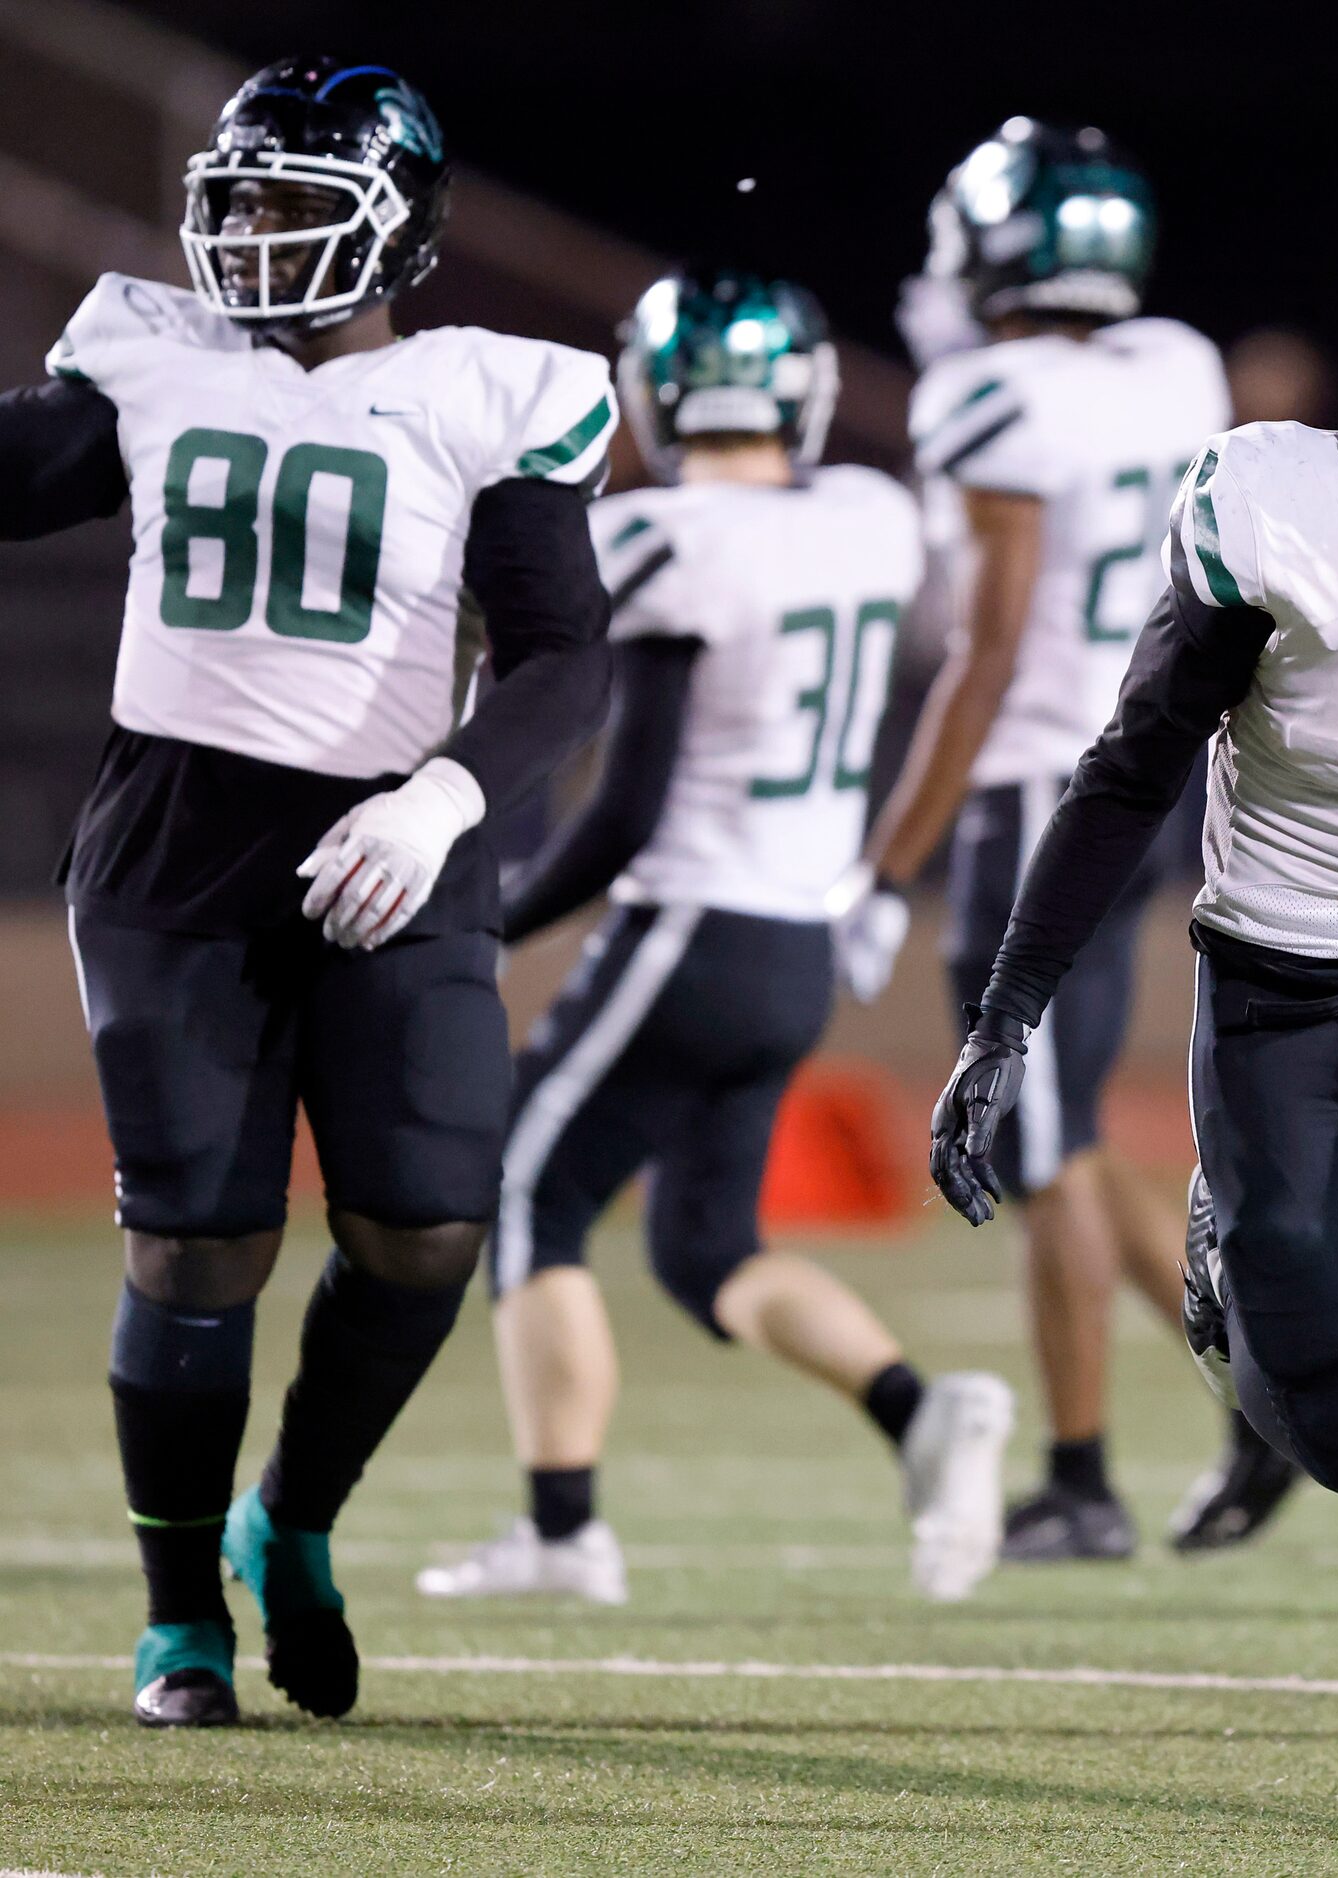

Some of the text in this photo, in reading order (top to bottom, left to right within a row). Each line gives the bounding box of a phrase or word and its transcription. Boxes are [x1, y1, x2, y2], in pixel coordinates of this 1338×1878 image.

[159, 427, 388, 644] 80
[1082, 464, 1197, 643] 2
[747, 600, 899, 799] 30
